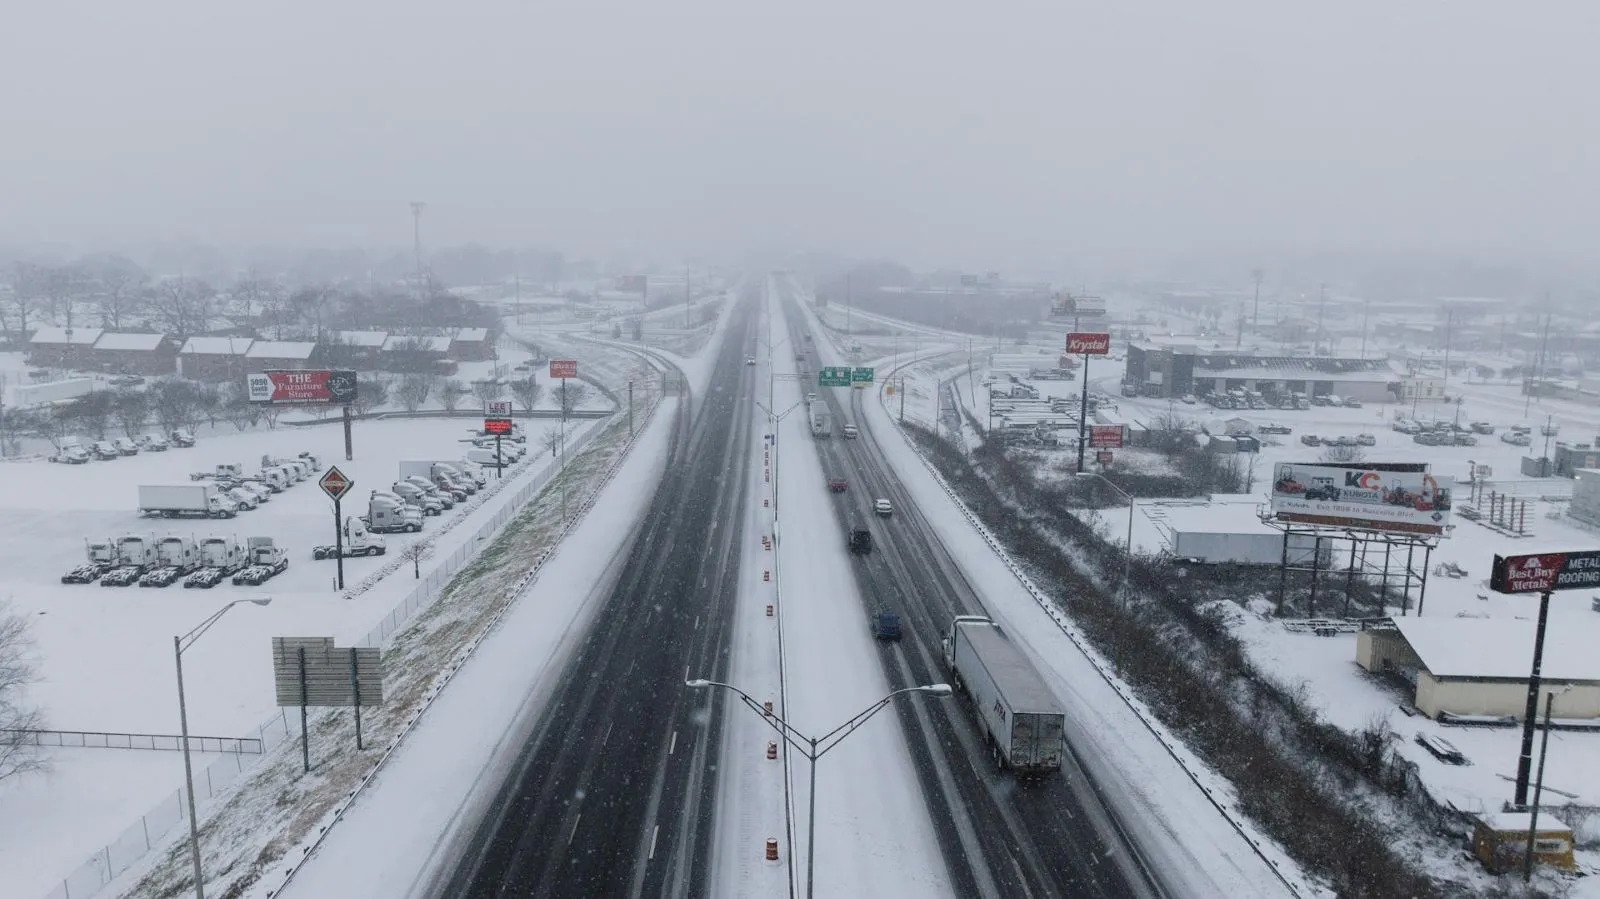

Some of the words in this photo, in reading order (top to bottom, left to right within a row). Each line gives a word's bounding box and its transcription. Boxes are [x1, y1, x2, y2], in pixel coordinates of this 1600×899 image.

[1068, 337, 1107, 353] Krystal
[287, 374, 311, 383] THE
[278, 383, 322, 391] Furniture
[289, 390, 312, 398] Store
[1345, 471, 1380, 491] KC
[1342, 489, 1378, 499] KUBOTA
[1568, 557, 1600, 569] METAL
[1508, 567, 1531, 579] Best
[1534, 566, 1556, 579] Buy
[1558, 571, 1600, 583] ROOFING
[1511, 579, 1548, 590] Metals
